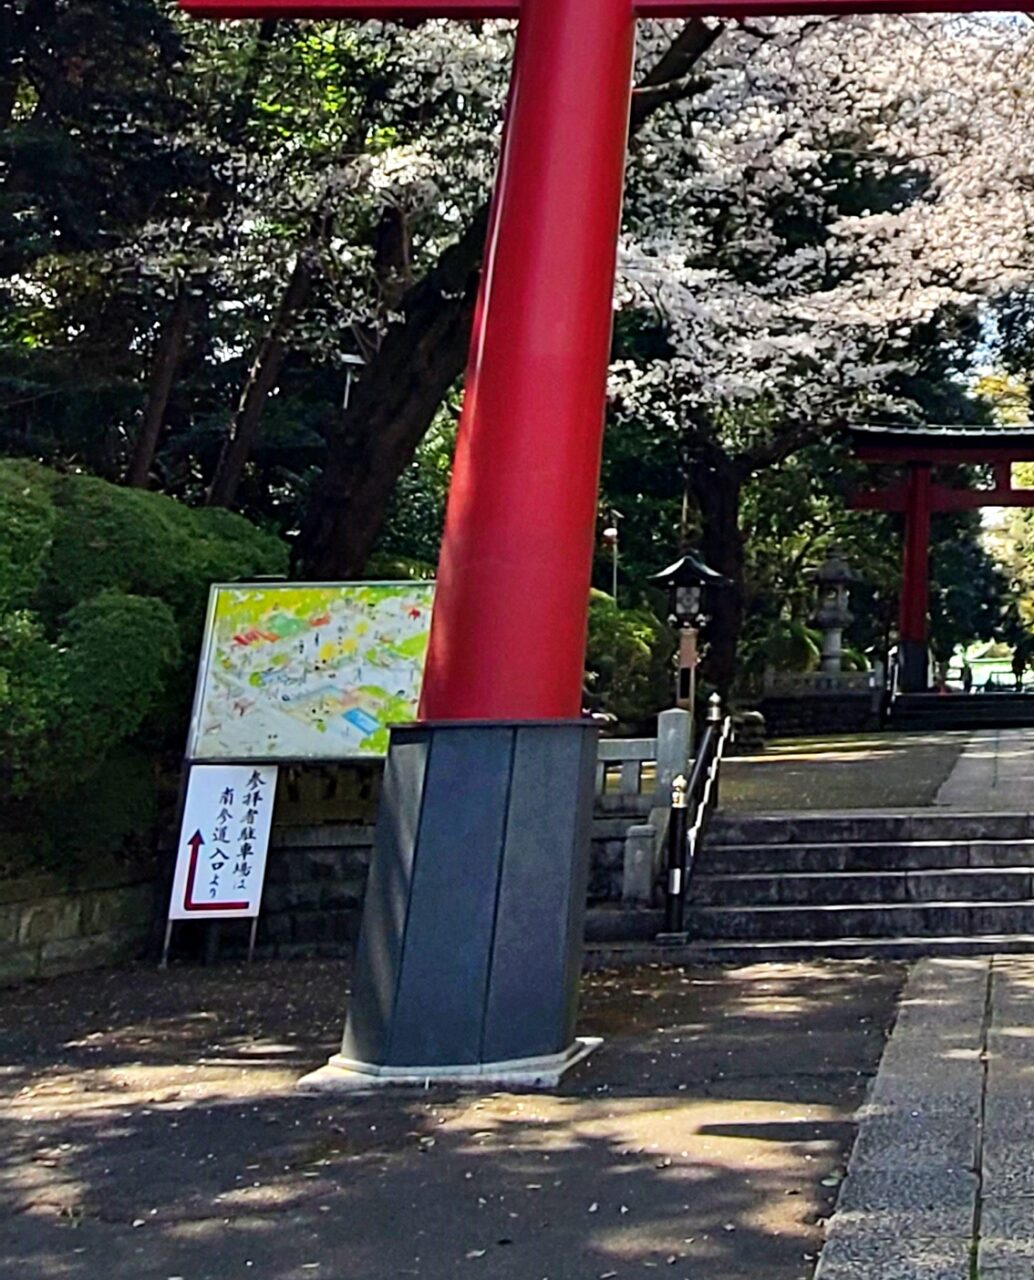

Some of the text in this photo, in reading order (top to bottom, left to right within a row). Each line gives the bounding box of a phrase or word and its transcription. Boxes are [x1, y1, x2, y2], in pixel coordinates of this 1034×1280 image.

[209, 786, 235, 898] 南参道入口より
[232, 769, 267, 890] 参拝者駐車場は
